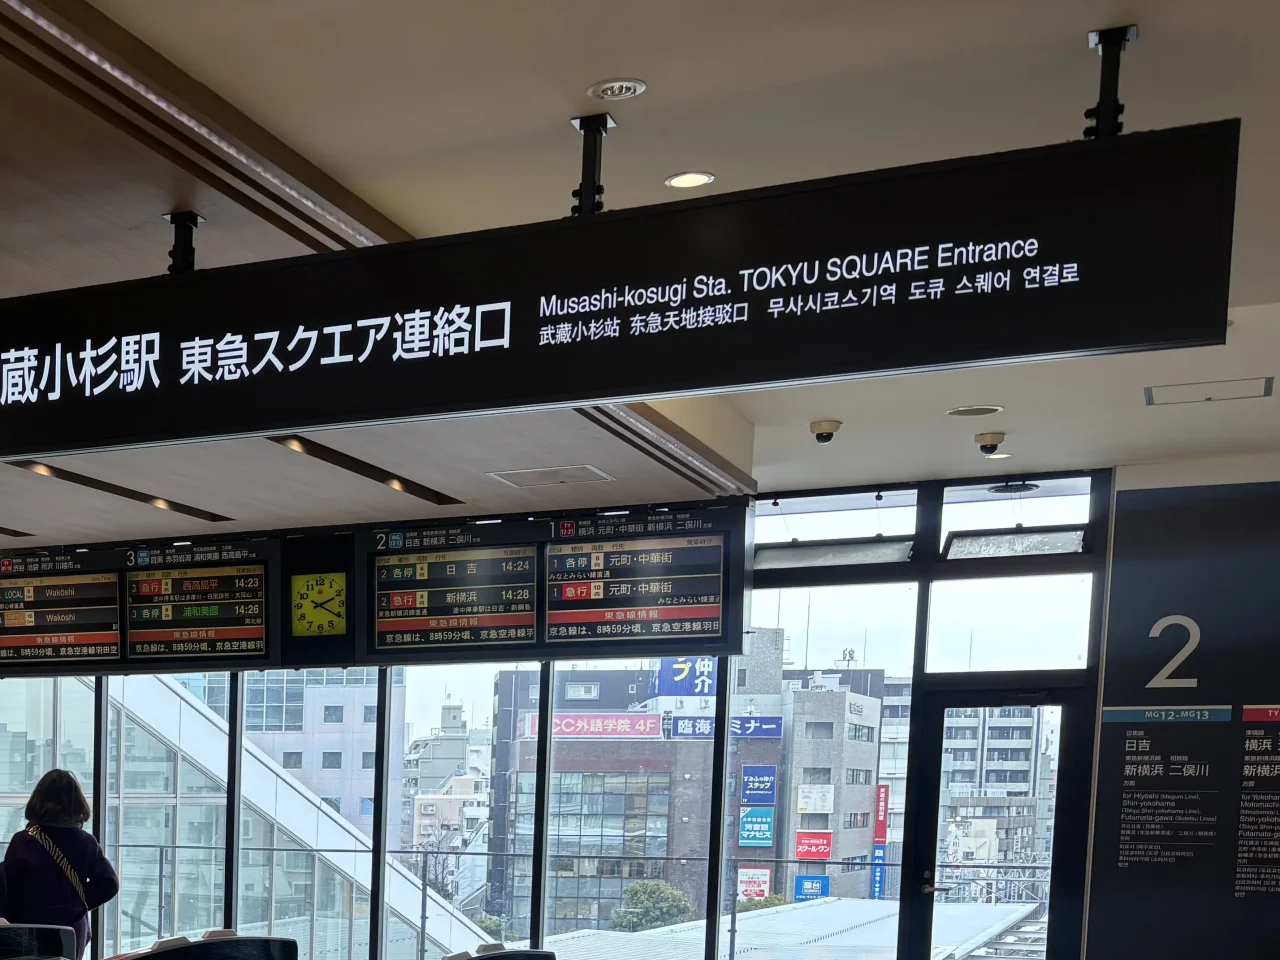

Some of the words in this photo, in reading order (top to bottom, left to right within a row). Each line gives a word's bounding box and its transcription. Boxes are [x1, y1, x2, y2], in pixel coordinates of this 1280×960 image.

[539, 278, 687, 317] Musashi-kosugi
[693, 275, 732, 298] Sta.
[739, 260, 819, 292] TOKYU
[826, 246, 930, 282] SQUARE
[937, 238, 1038, 267] Entrance
[767, 282, 897, 319] 무사시코스기역
[908, 278, 945, 300] 도큐
[954, 269, 1011, 294] 스퀘어
[1023, 262, 1079, 289] 연결로
[630, 303, 749, 336] 东急天地接驳口
[180, 300, 512, 385] 東急スクエア連絡口
[549, 522, 555, 538] 1
[578, 526, 595, 536] 横浜
[598, 524, 644, 535] 元町・中華街
[647, 521, 673, 532] 新横浜
[676, 520, 702, 530] 二俣川
[376, 533, 386, 550] 2
[405, 538, 420, 547] 日吉
[423, 536, 446, 546] 新横浜
[126, 551, 135, 566] 3
[221, 550, 248, 560] 西高島平
[565, 557, 588, 568] 各停
[609, 552, 672, 566] 元町・中華街
[381, 570, 387, 578] 2
[392, 567, 413, 578] 各停
[501, 561, 530, 572] 14:24
[142, 583, 159, 593] 急行
[183, 580, 218, 591] 西高島平
[234, 578, 259, 588] 14:23
[306, 583, 314, 591] 11
[316, 578, 325, 586] 12
[5, 591, 23, 599] LOCAL
[335, 589, 342, 597] 2
[565, 586, 587, 597] 急行
[609, 581, 672, 596] 元町・中華街
[300, 592, 308, 600] 10
[381, 597, 387, 606] 2
[393, 595, 413, 606] 急行
[445, 591, 477, 604] 新横浜
[501, 590, 530, 600] 14:28
[296, 602, 303, 610] 9
[338, 600, 344, 608] 3
[132, 610, 137, 618] 3
[142, 608, 159, 618] 各停
[183, 605, 219, 617] 浦和美園
[234, 604, 259, 614] 14:26
[605, 610, 659, 620] 東急線情報
[307, 621, 313, 629] 7
[429, 618, 479, 628] 東急線情報
[173, 630, 216, 639] 東急線情報
[1144, 614, 1201, 688] 2
[695, 658, 713, 694] 仲介
[1145, 711, 1209, 720] MG12-MG13
[536, 719, 630, 732] CC外語学院
[635, 719, 656, 731] 4F
[677, 719, 777, 735] 臨海ミナー
[1125, 739, 1151, 751] 日吉
[1244, 739, 1272, 751] 横浜
[1124, 764, 1164, 776] 新横浜
[1169, 764, 1209, 776] 二俣川
